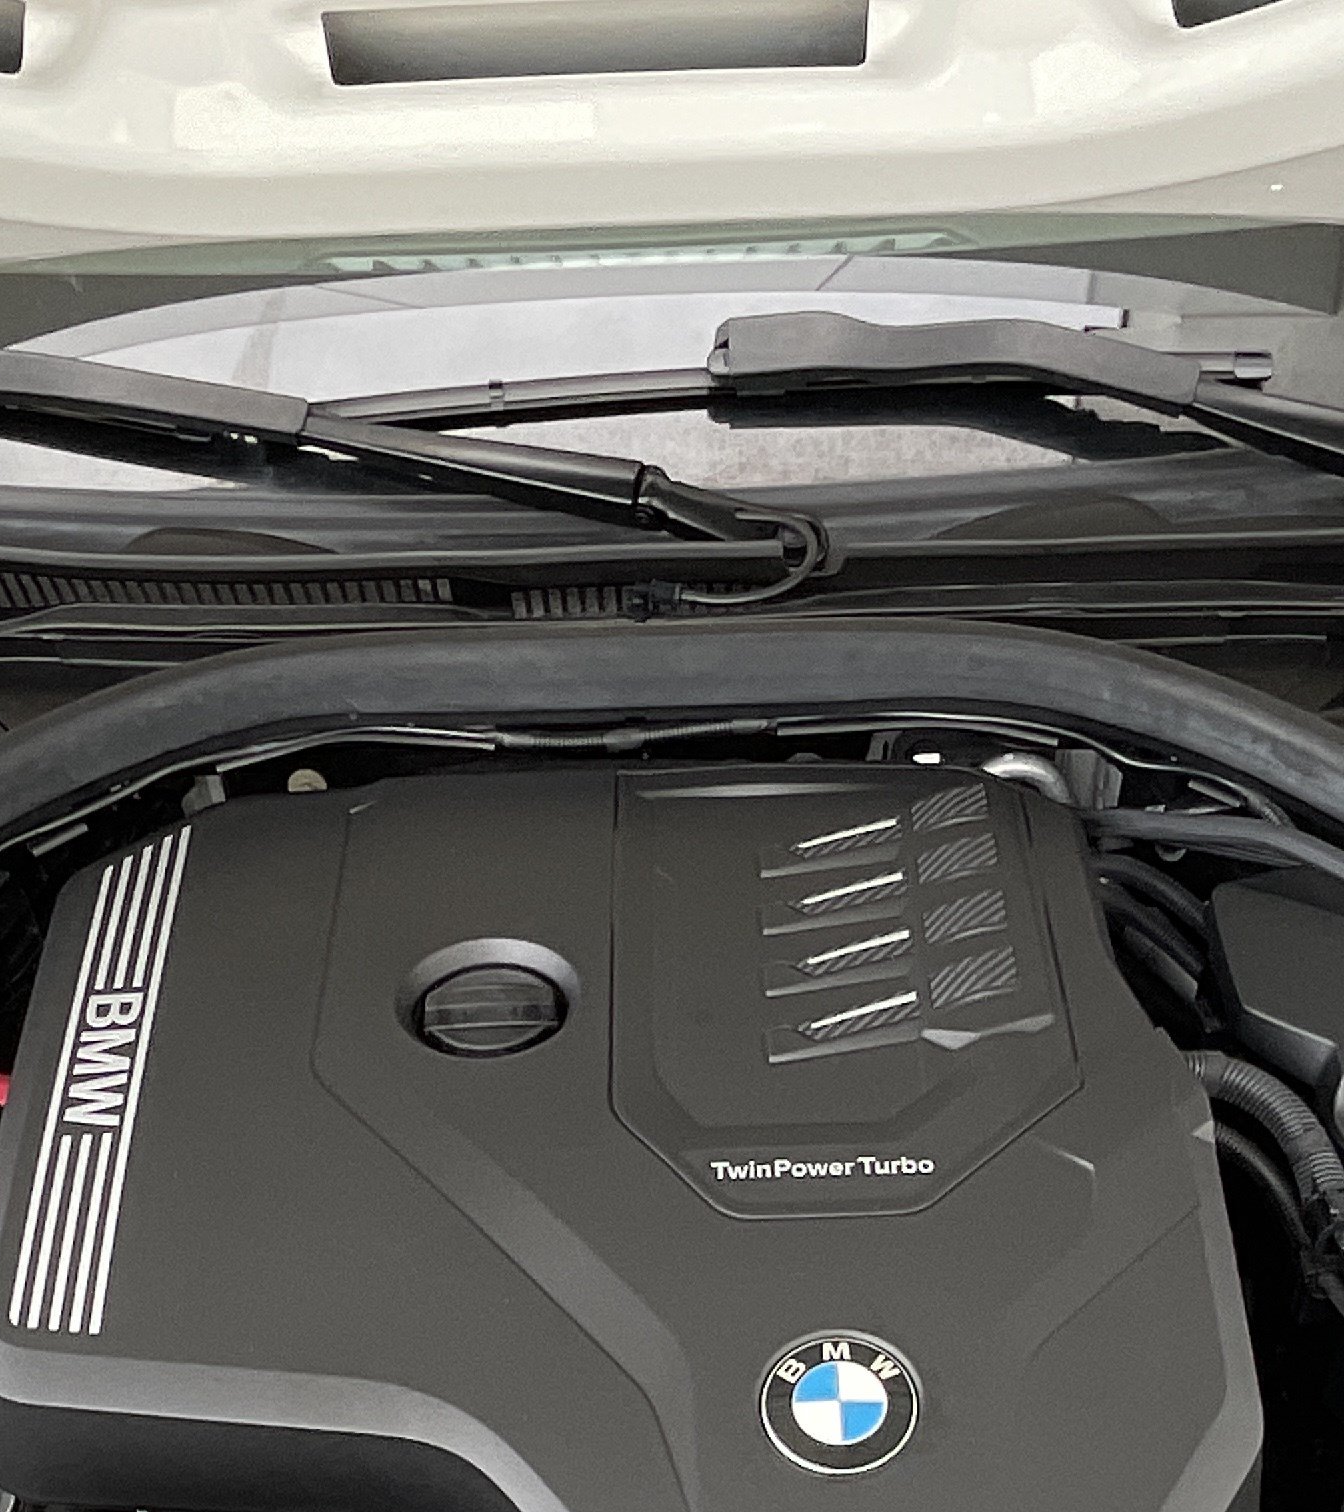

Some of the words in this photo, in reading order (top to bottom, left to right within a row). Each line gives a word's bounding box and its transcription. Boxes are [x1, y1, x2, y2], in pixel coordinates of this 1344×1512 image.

[63, 992, 144, 1126] BMW
[856, 1156, 935, 1175] Turbo
[776, 1341, 901, 1384] BMW
